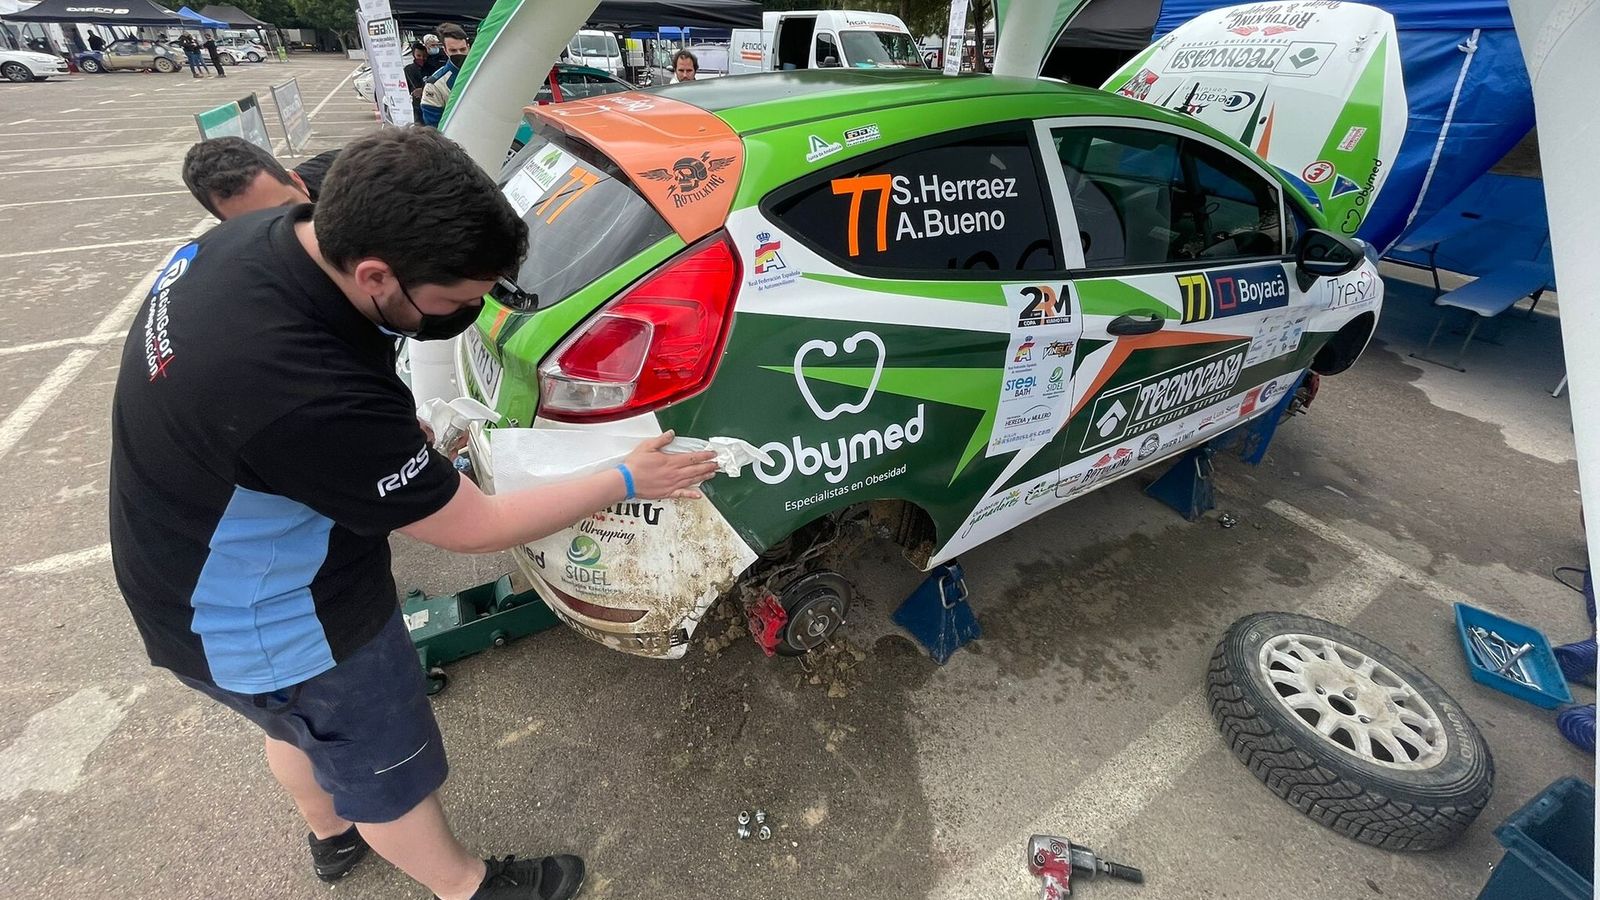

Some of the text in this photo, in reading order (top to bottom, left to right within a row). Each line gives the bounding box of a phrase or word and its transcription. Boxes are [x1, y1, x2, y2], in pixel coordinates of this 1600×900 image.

[1226, 11, 1316, 30] ROTULKING
[1171, 47, 1280, 69] TECNOCASA
[536, 166, 600, 225] 77
[673, 174, 725, 208] ROTULKING
[892, 174, 1018, 205] S.Herraez
[1355, 158, 1382, 206] Obymed
[831, 174, 892, 257] 77
[895, 209, 1006, 241] A.Bueno
[1019, 285, 1072, 319] 2RM
[1178, 274, 1208, 323] 77
[1014, 388, 1032, 398] BATH
[1046, 382, 1064, 393] SIDEL
[1135, 352, 1244, 422] TECNOCASA
[752, 403, 925, 485] Obymed
[376, 443, 431, 498] RRS
[784, 463, 907, 512] Especialistas en Obesidad
[580, 519, 636, 546] Wrapping
[565, 565, 611, 586] SIDEL
